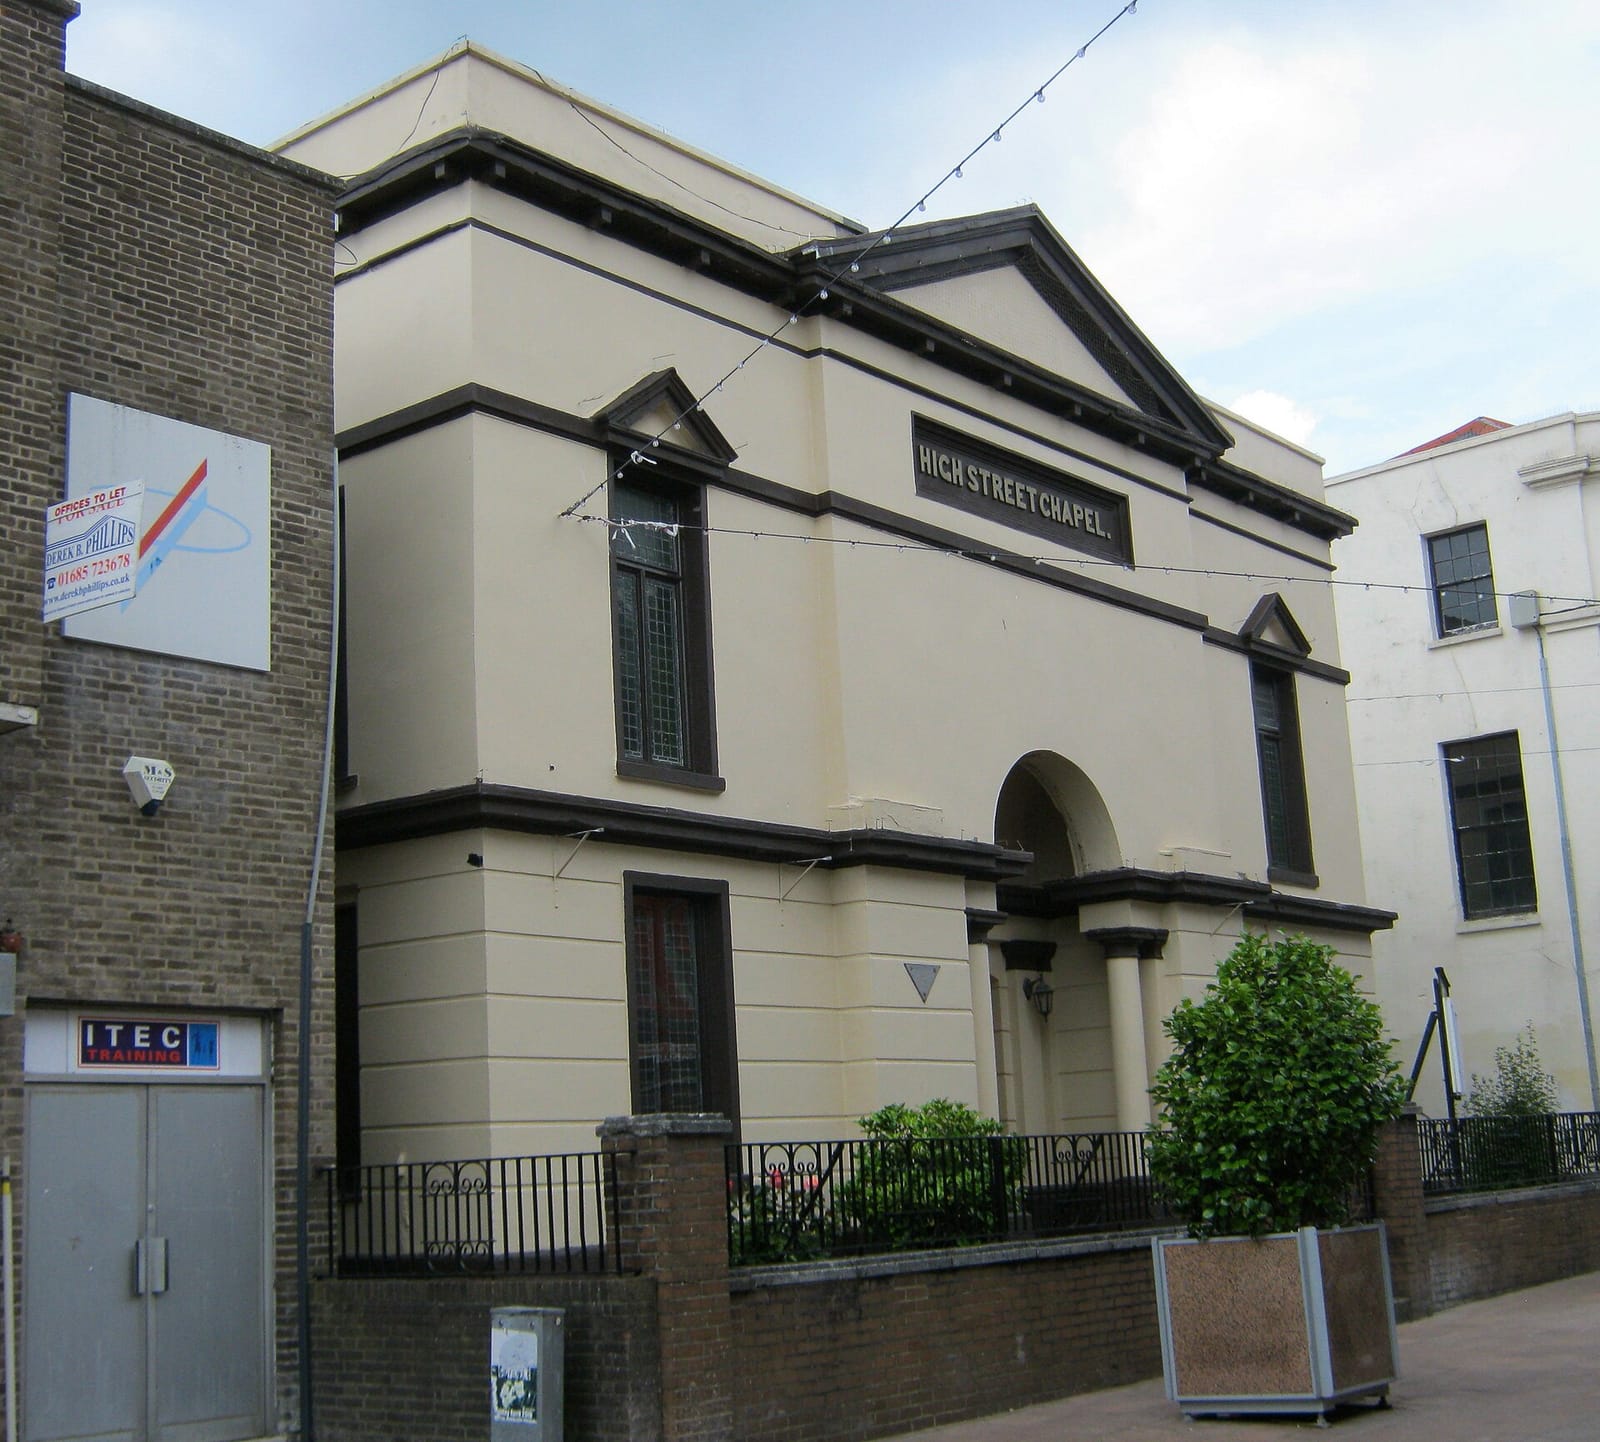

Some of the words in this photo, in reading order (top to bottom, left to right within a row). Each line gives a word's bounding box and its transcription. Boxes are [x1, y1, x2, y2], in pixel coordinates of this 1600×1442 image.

[54, 498, 90, 517] OFFICES
[94, 493, 106, 504] TO
[109, 487, 127, 499] LET
[919, 444, 964, 488] HIGH
[967, 464, 1037, 513] STREET
[1039, 492, 1112, 540] CHAPEL.
[46, 545, 74, 566] DEREK
[86, 520, 135, 555] PHILLIPS
[57, 565, 88, 587] 01685
[92, 553, 131, 575] 723678
[44, 573, 130, 605] www.derekbphillips.co.uk
[86, 1024, 181, 1049] ITEC
[87, 1048, 181, 1063] TRAINING
